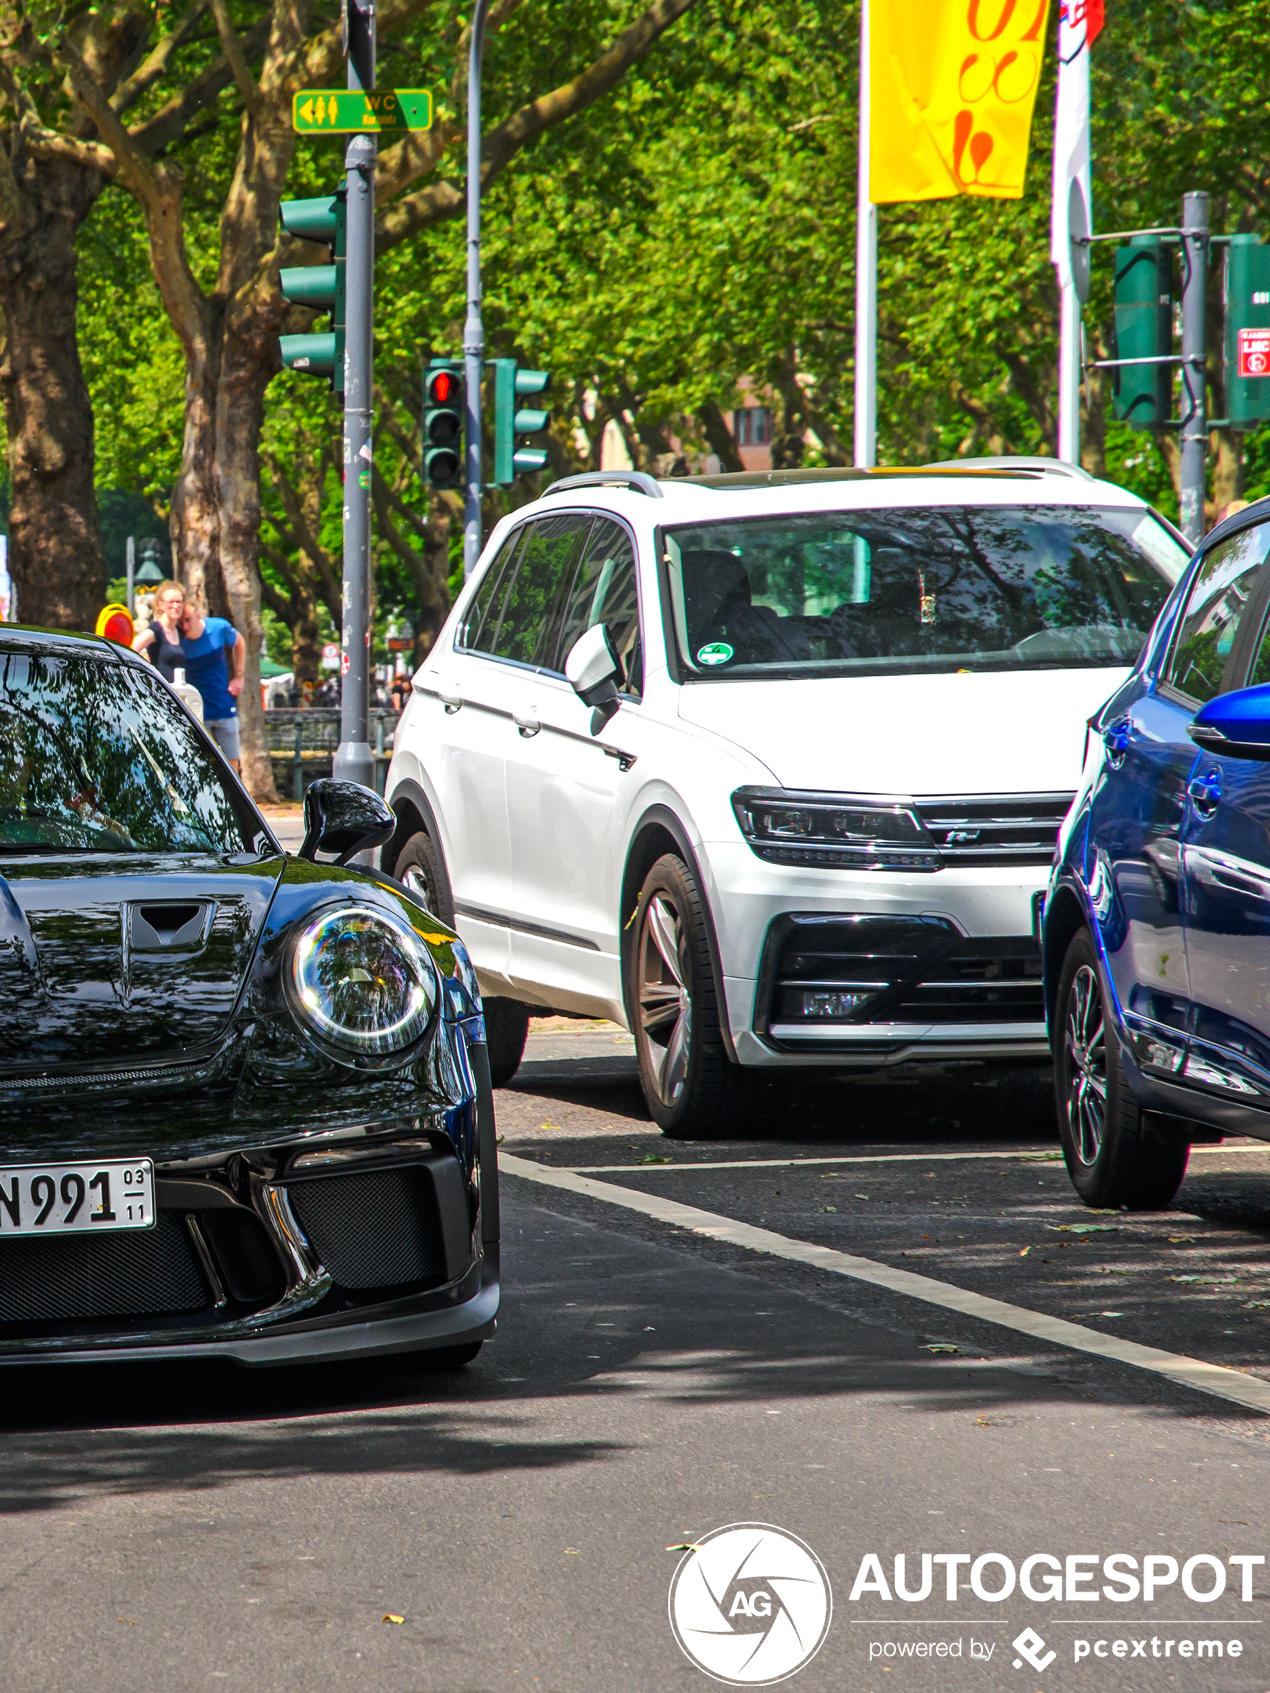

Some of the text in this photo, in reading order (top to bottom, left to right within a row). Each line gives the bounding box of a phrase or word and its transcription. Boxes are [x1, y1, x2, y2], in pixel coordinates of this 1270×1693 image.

[364, 95, 395, 111] WC
[712, 645, 721, 653] 4
[123, 1168, 145, 1184] 03
[126, 1203, 145, 1220] 11
